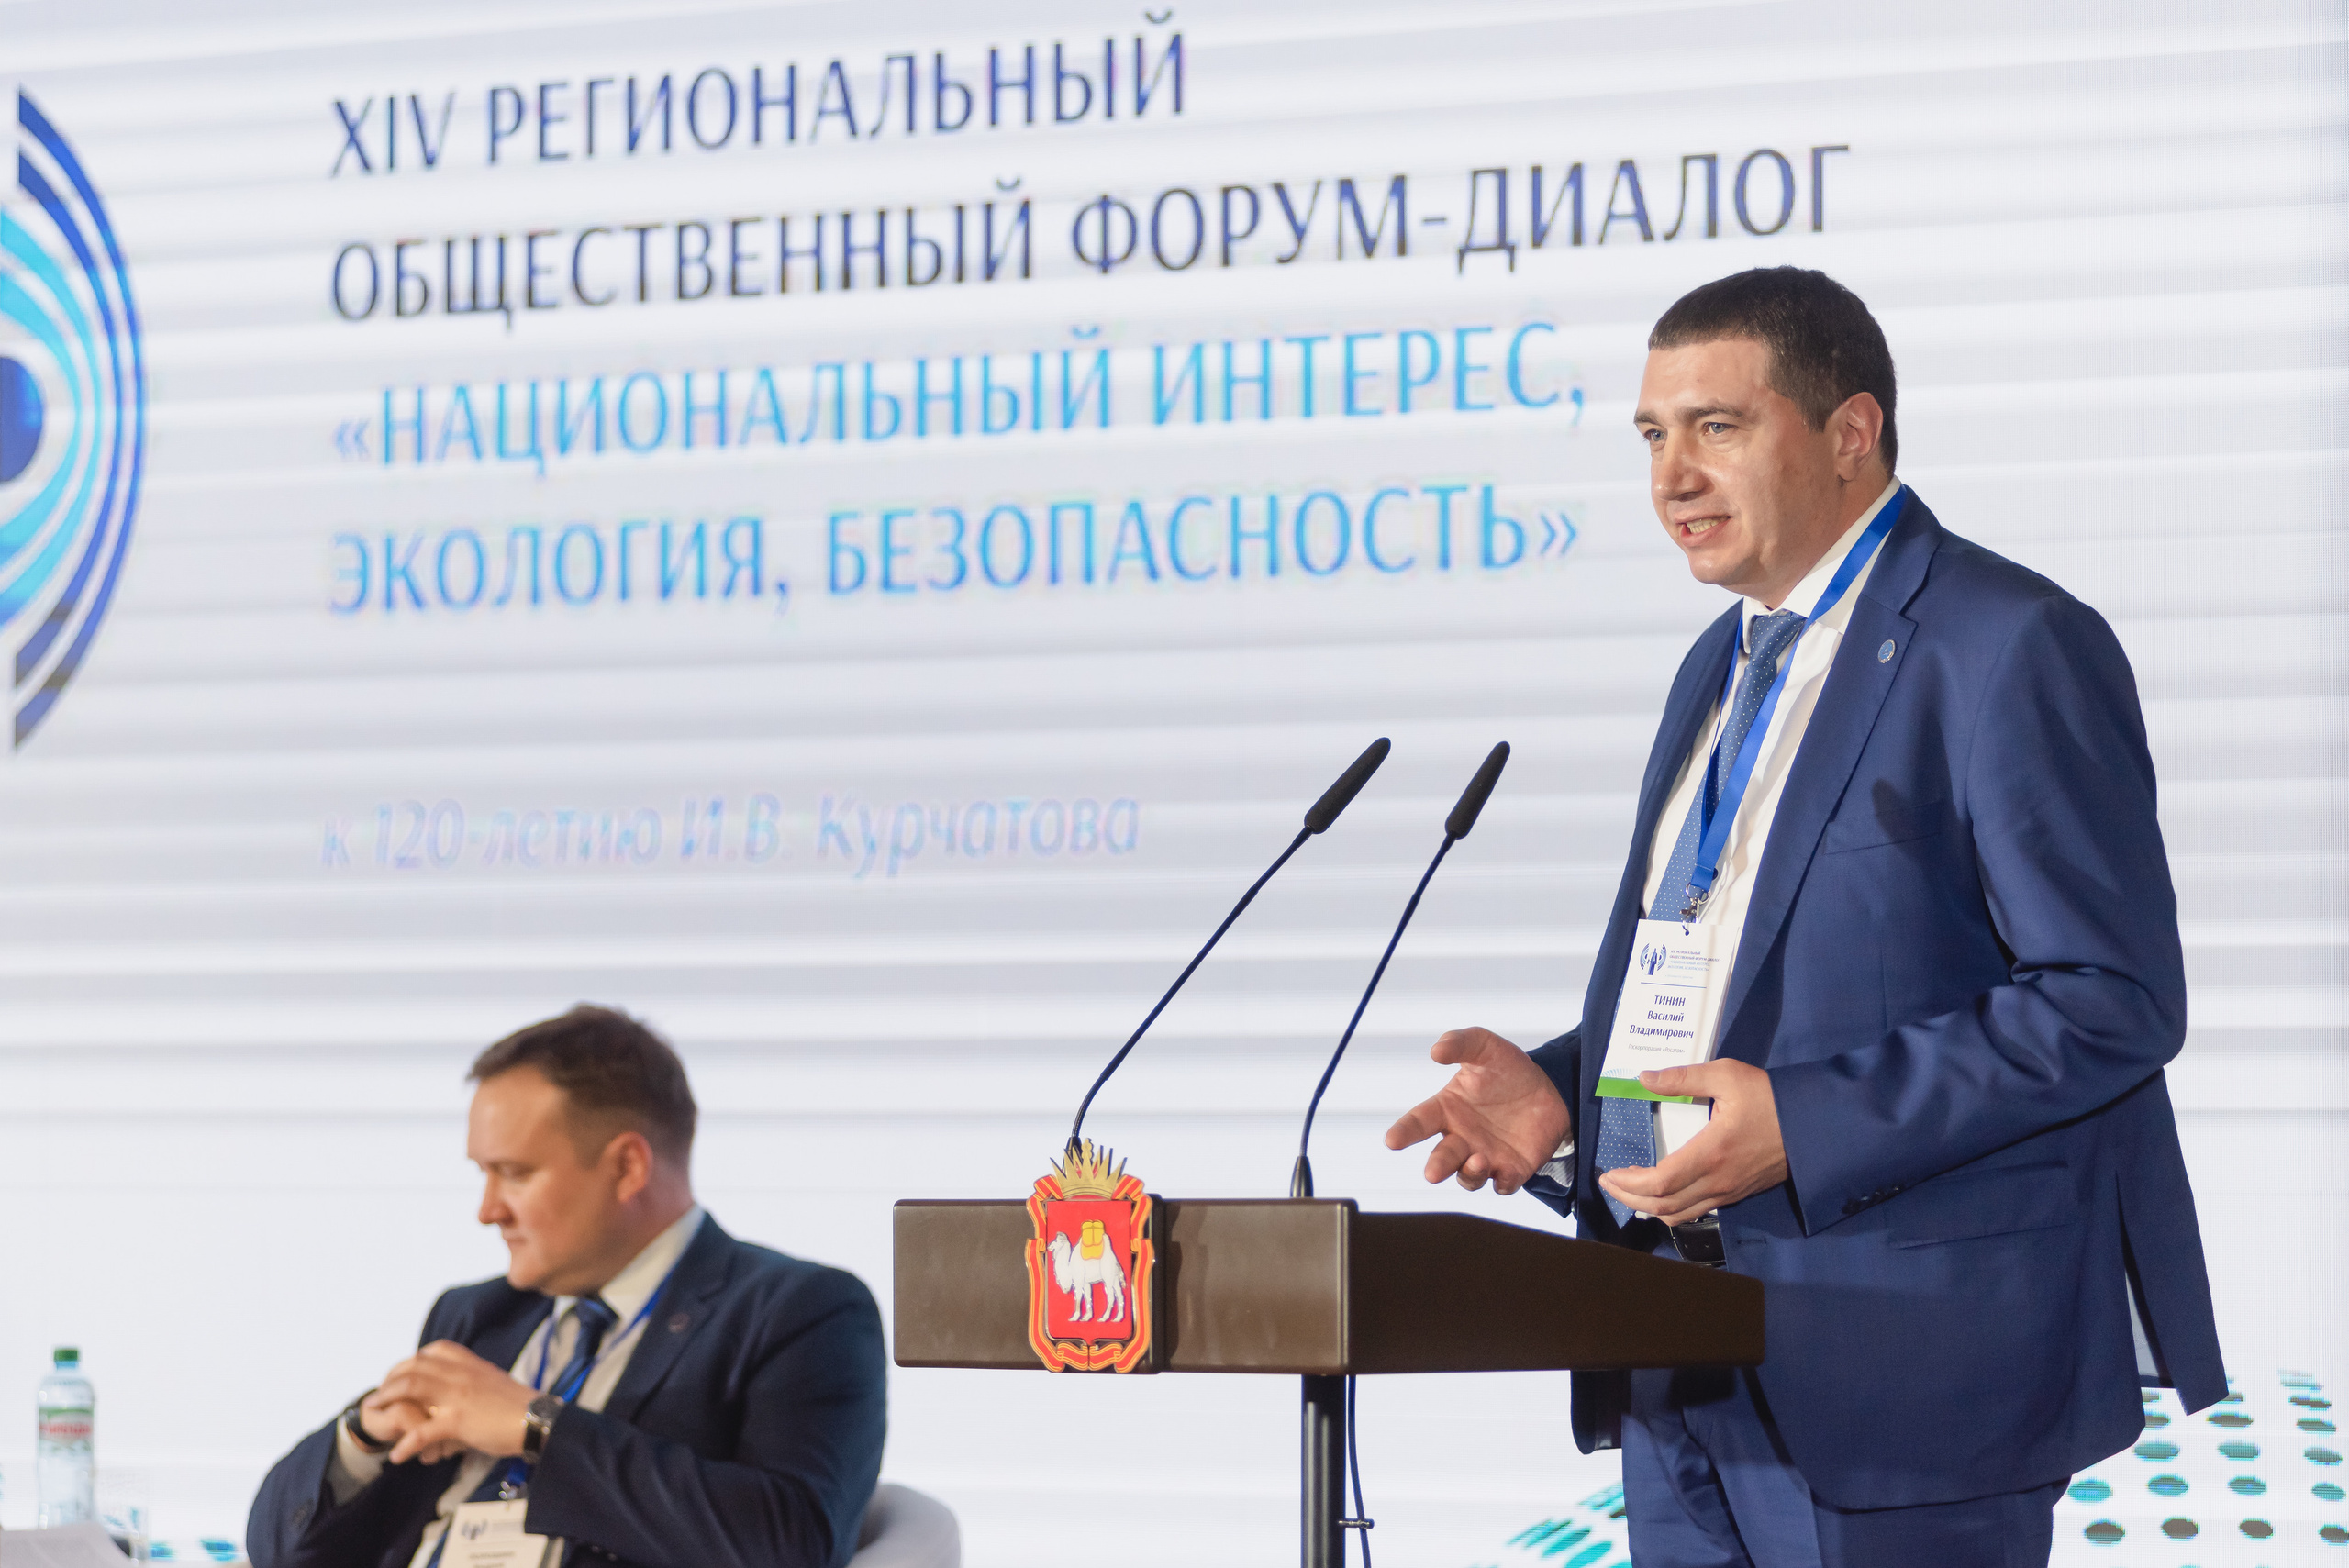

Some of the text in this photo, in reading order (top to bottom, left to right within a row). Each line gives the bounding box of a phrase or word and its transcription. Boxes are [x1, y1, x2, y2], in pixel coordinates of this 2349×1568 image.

[329, 11, 1186, 179] XIV РЕГИОНАЛЬНЫЙ
[331, 143, 1851, 334] ОБЩЕСТВЕННЫЙ ФОРУМ-ДИАЛОГ
[332, 321, 1586, 476] «НАЦИОНАЛЬНЫЙ ИНТЕРЕС,
[328, 483, 1579, 616] ЭКОЛОГИЯ, БЕЗОПАСНОСТЬ»
[373, 797, 662, 871] 120-летию
[815, 788, 1141, 881] Курчатова
[1629, 1024, 1695, 1040] Владимирович
[1647, 1010, 1685, 1022] Василий
[1653, 995, 1686, 1006] ТИНИН
